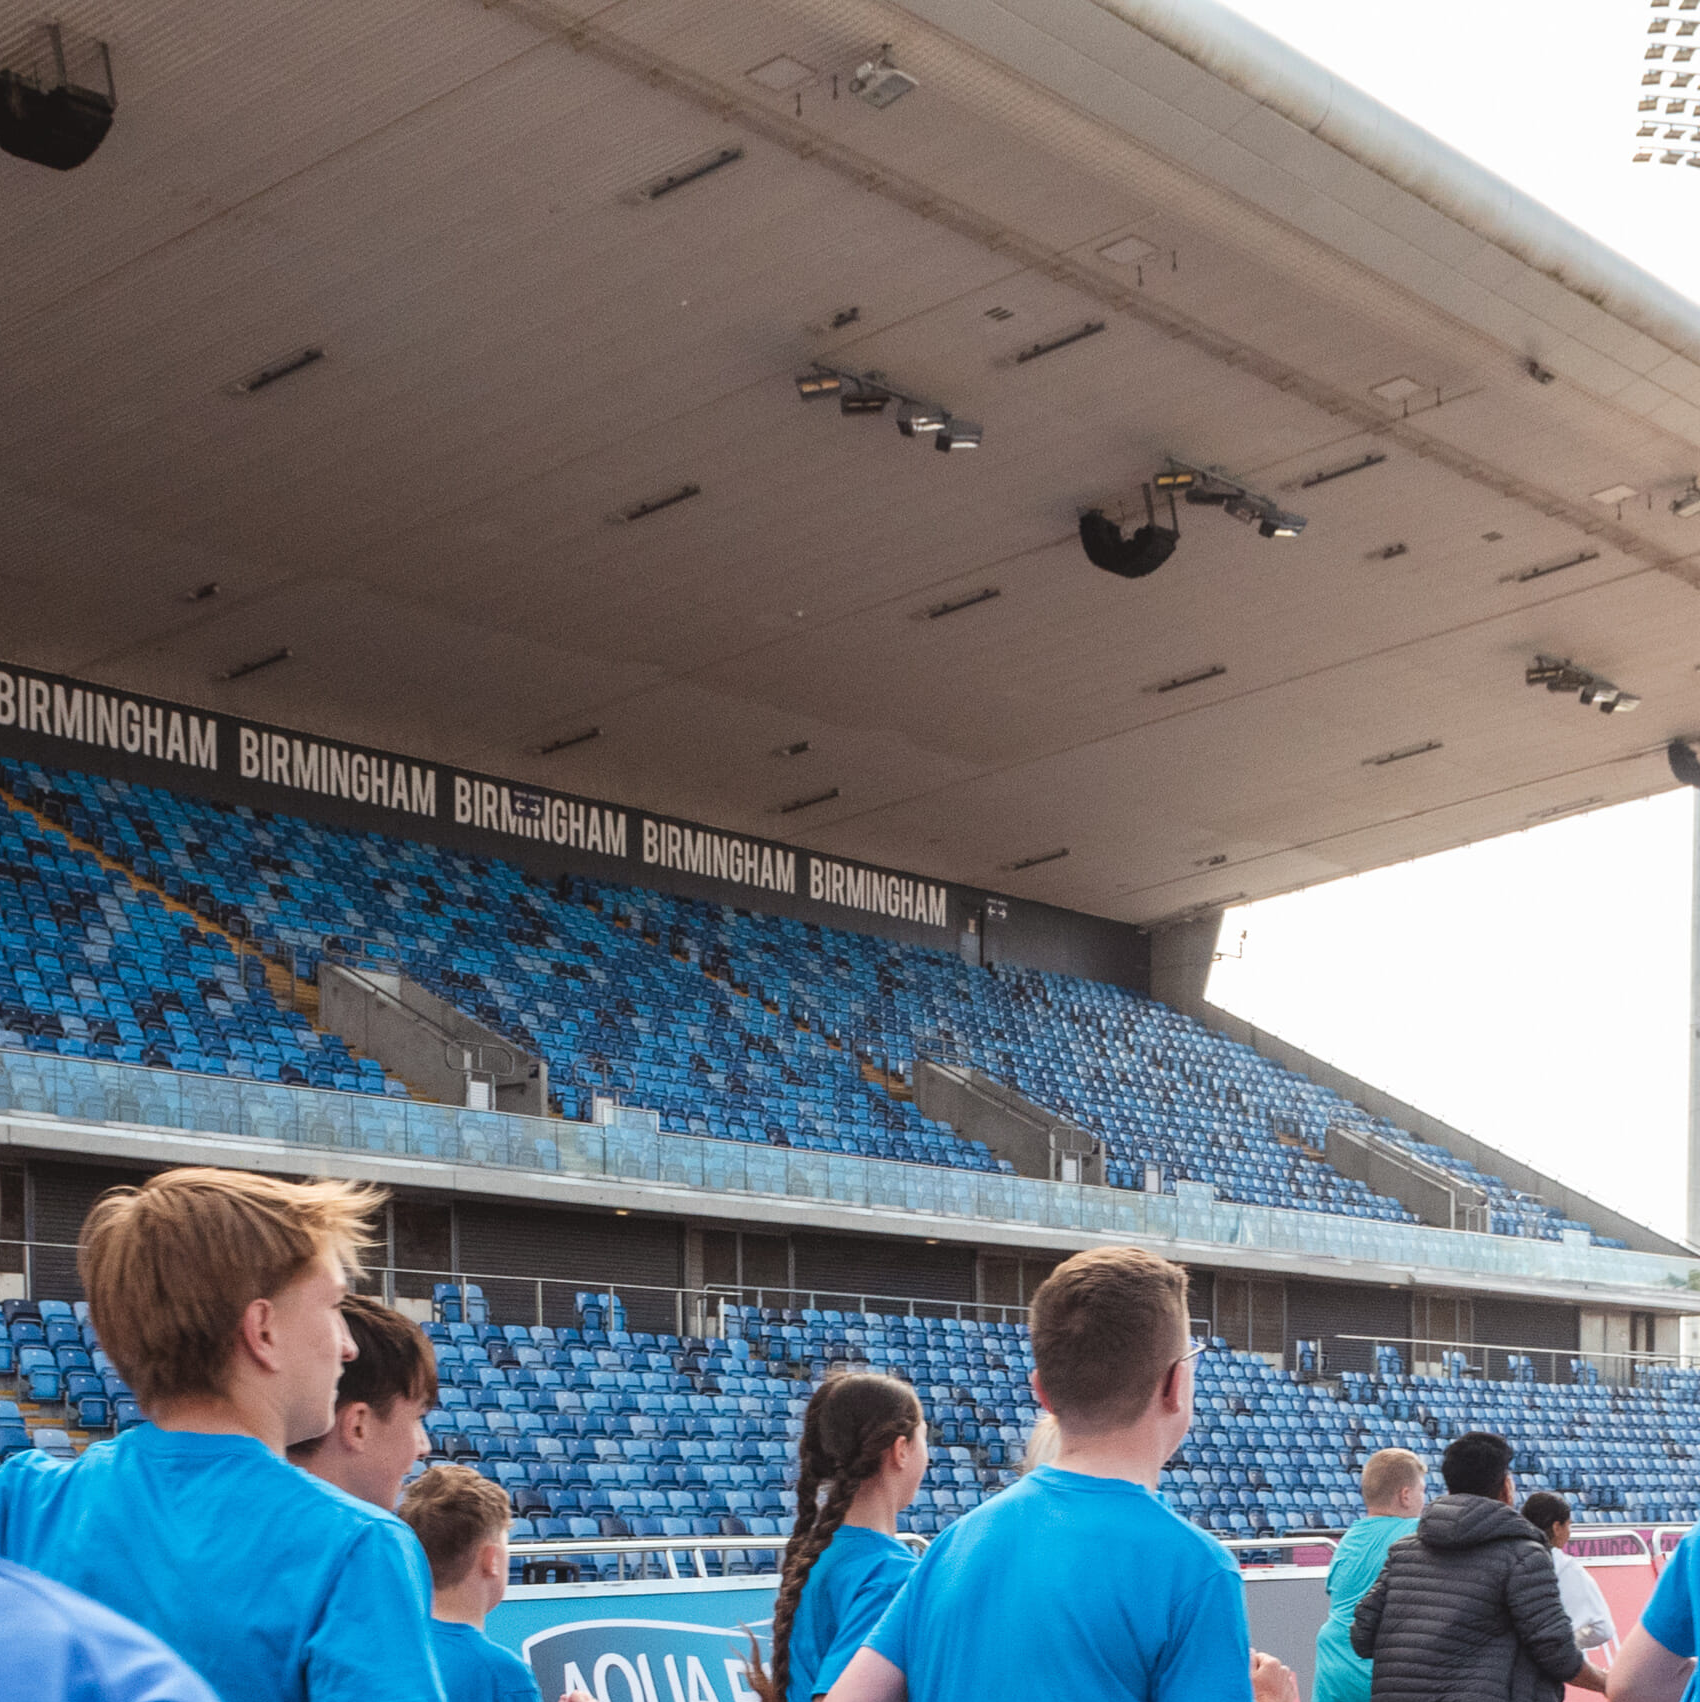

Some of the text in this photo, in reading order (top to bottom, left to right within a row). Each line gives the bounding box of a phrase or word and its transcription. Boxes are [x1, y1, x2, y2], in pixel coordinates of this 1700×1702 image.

[239, 727, 437, 818] BIRMINGHAM
[643, 818, 796, 894] BIRMINGHAM
[809, 856, 947, 928] BIRMINGHAM
